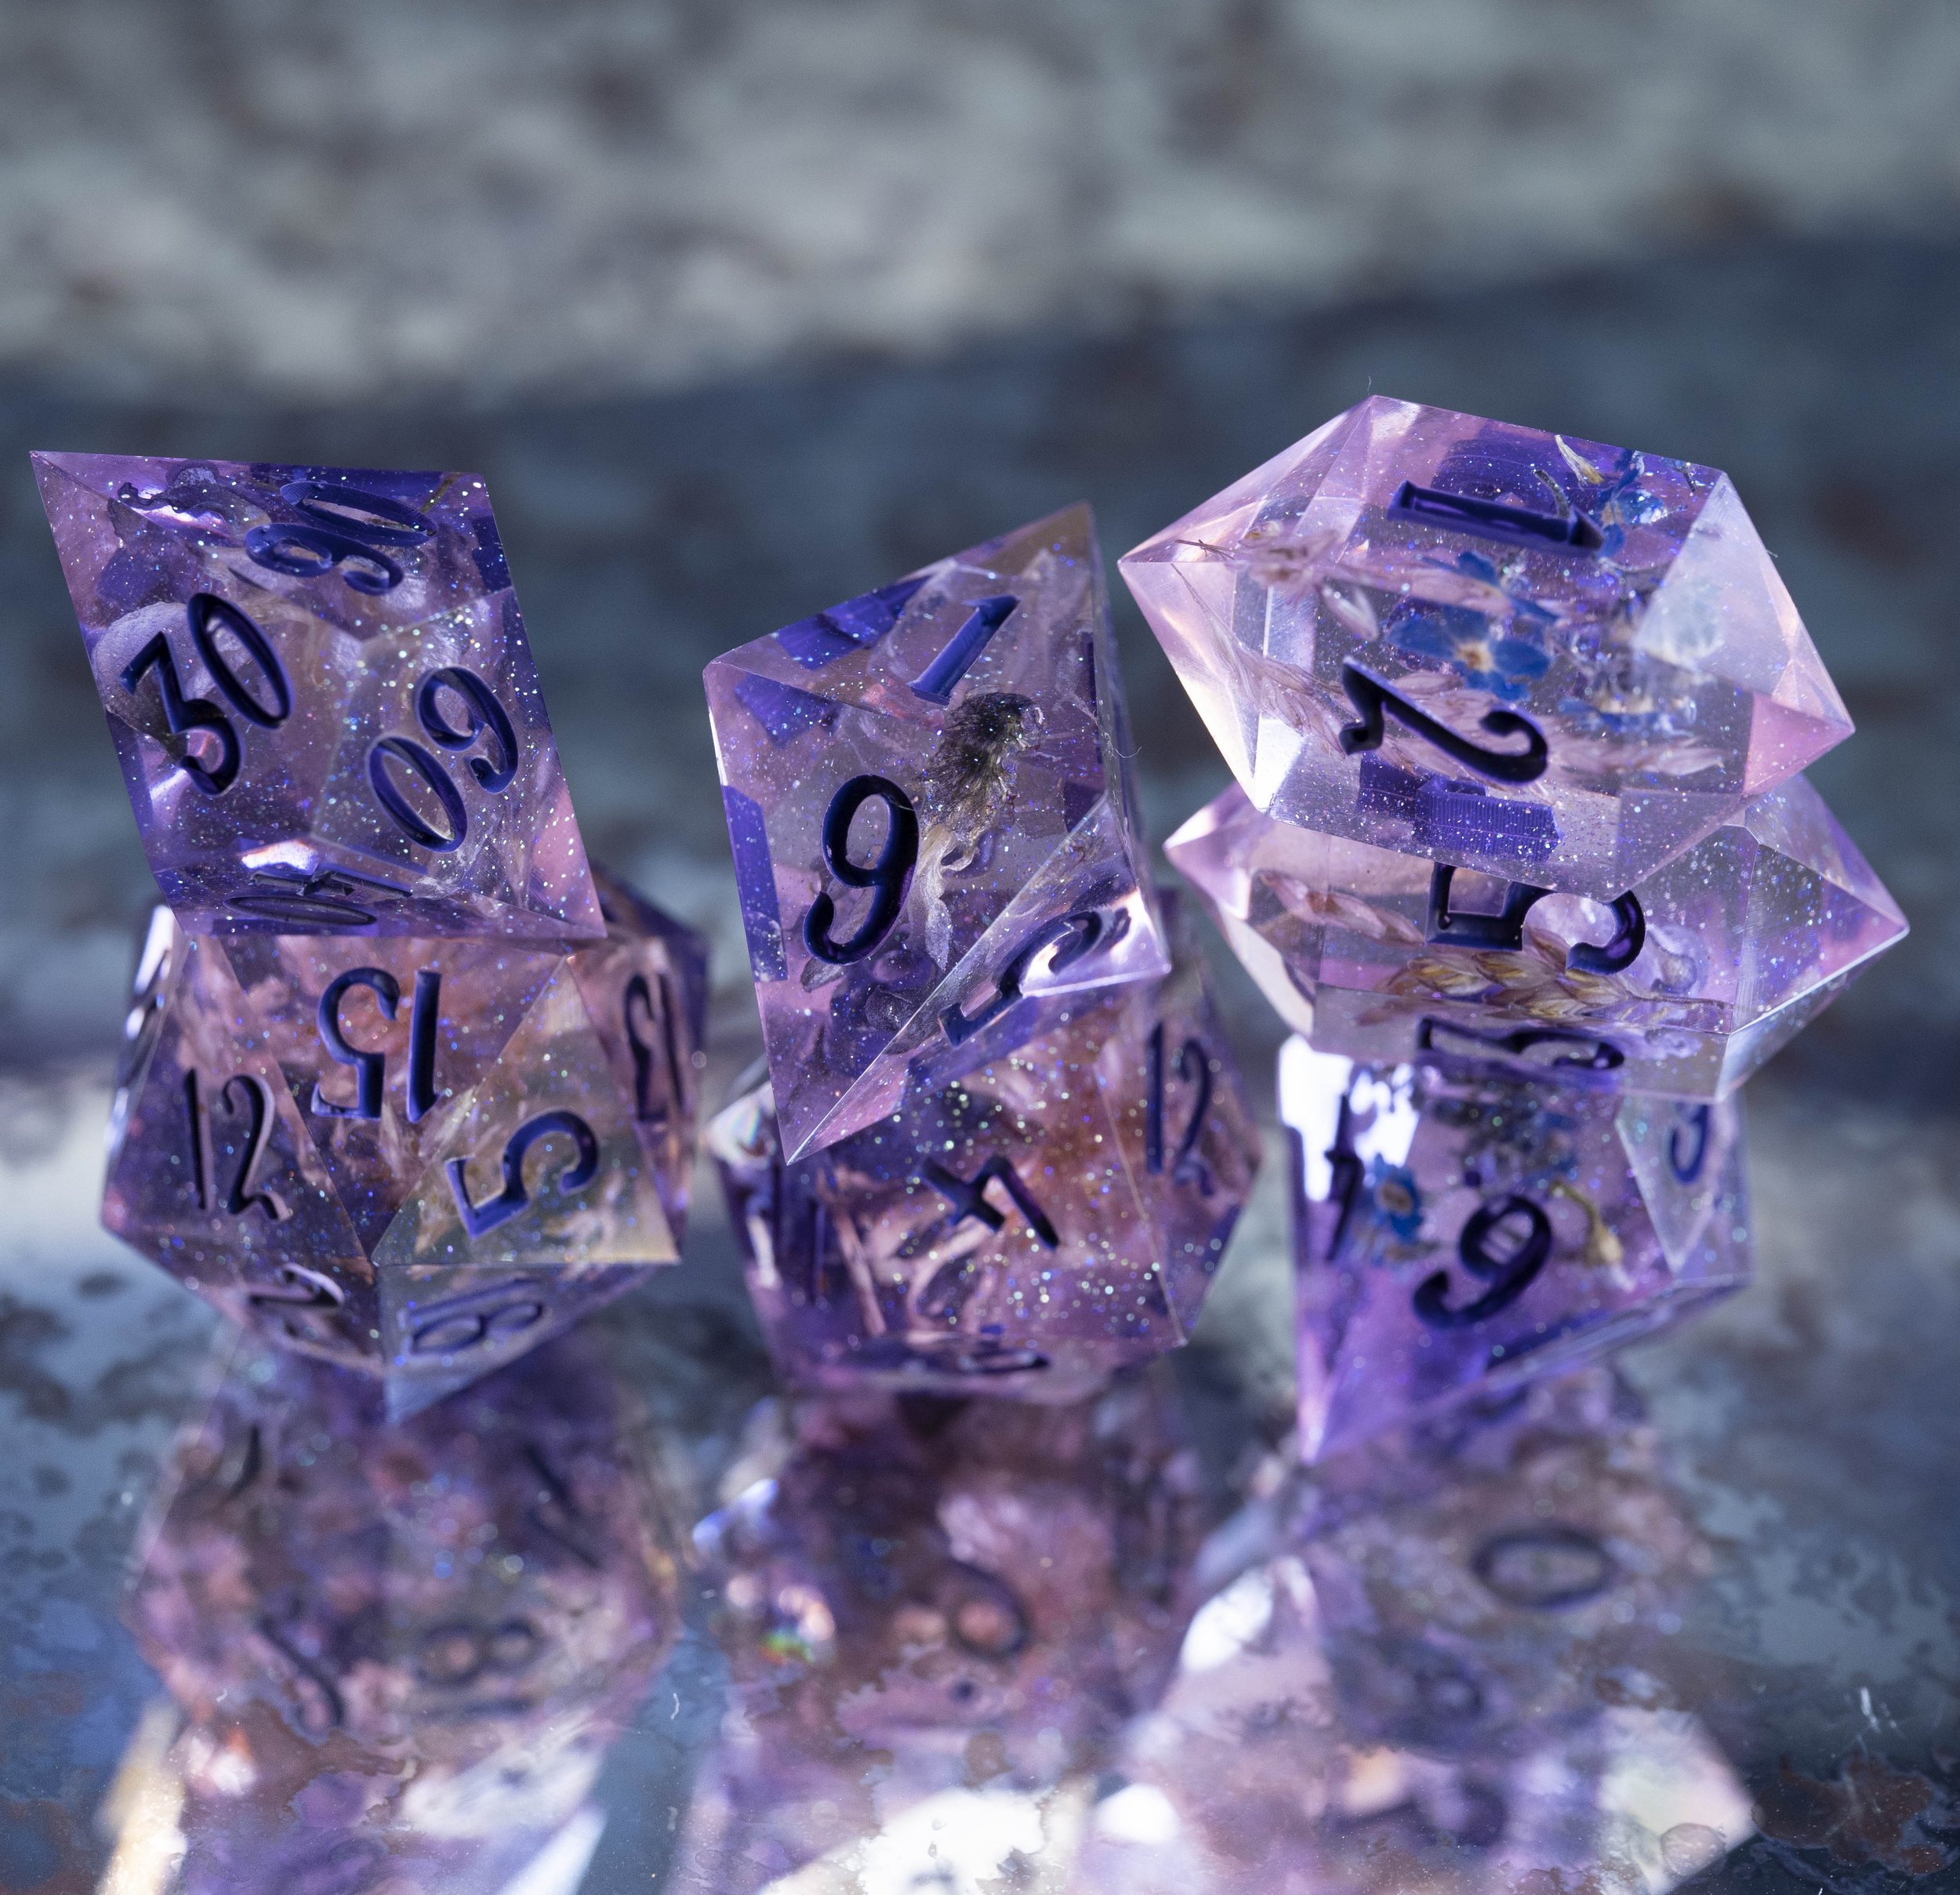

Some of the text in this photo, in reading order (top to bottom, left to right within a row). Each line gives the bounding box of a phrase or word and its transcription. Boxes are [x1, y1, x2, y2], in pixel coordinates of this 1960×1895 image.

[120, 592, 295, 797] 30
[1338, 655, 1548, 785] 2
[183, 1067, 292, 1223] 12
